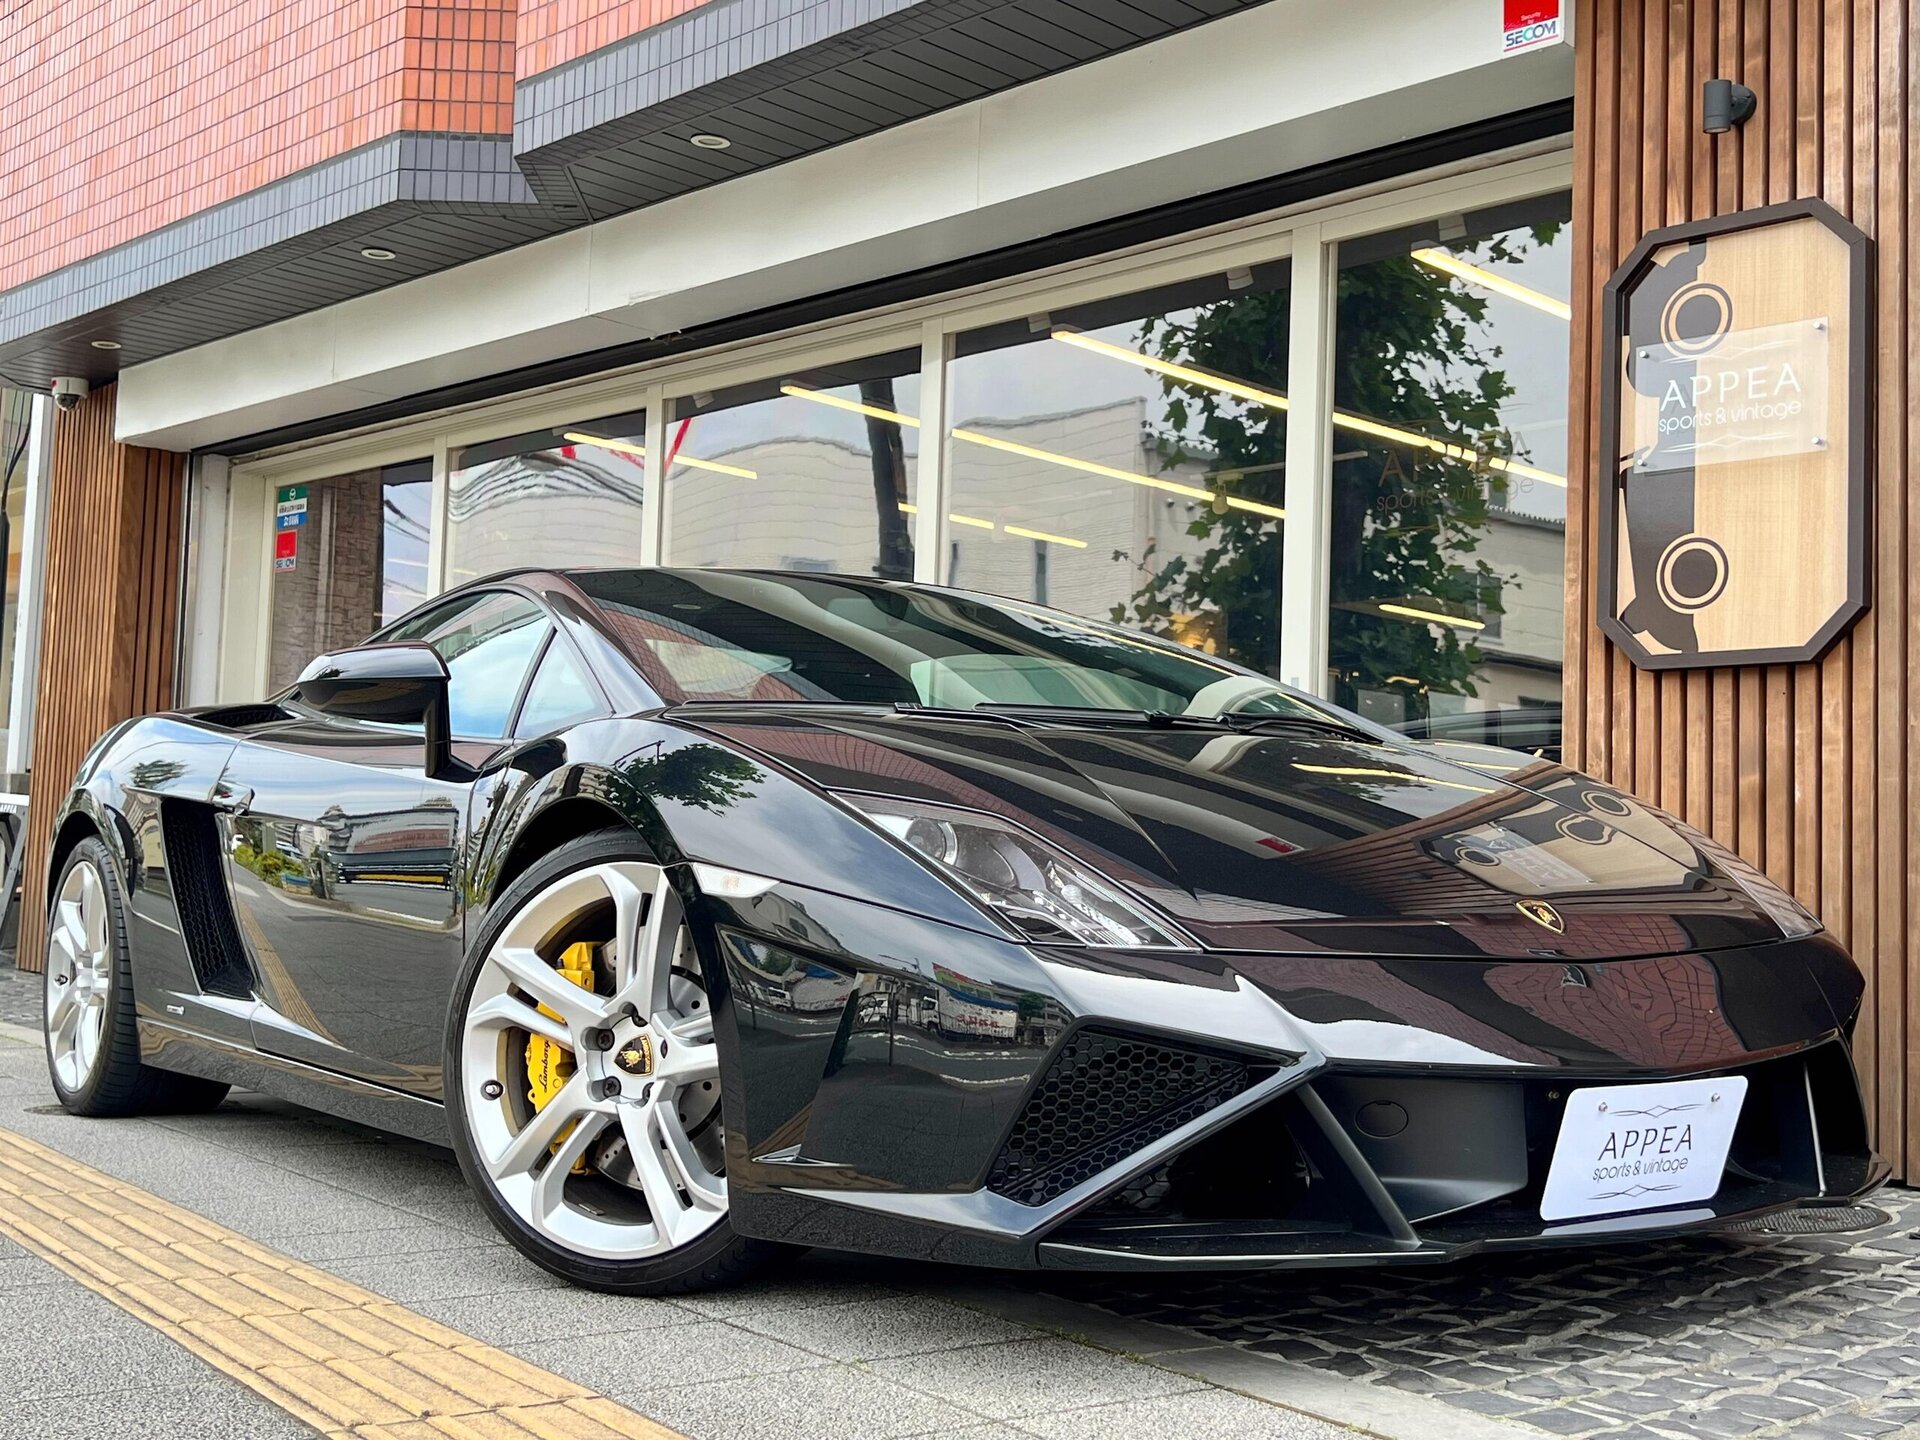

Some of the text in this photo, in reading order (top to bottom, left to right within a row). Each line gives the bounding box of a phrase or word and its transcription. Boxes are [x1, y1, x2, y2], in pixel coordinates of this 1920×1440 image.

[1505, 20, 1557, 47] SECOM
[1660, 362, 1802, 412] APPEA
[1659, 399, 1803, 435] sports & vintage
[1597, 1124, 1692, 1161] APPEA
[1592, 1156, 1689, 1183] sports & vintage
